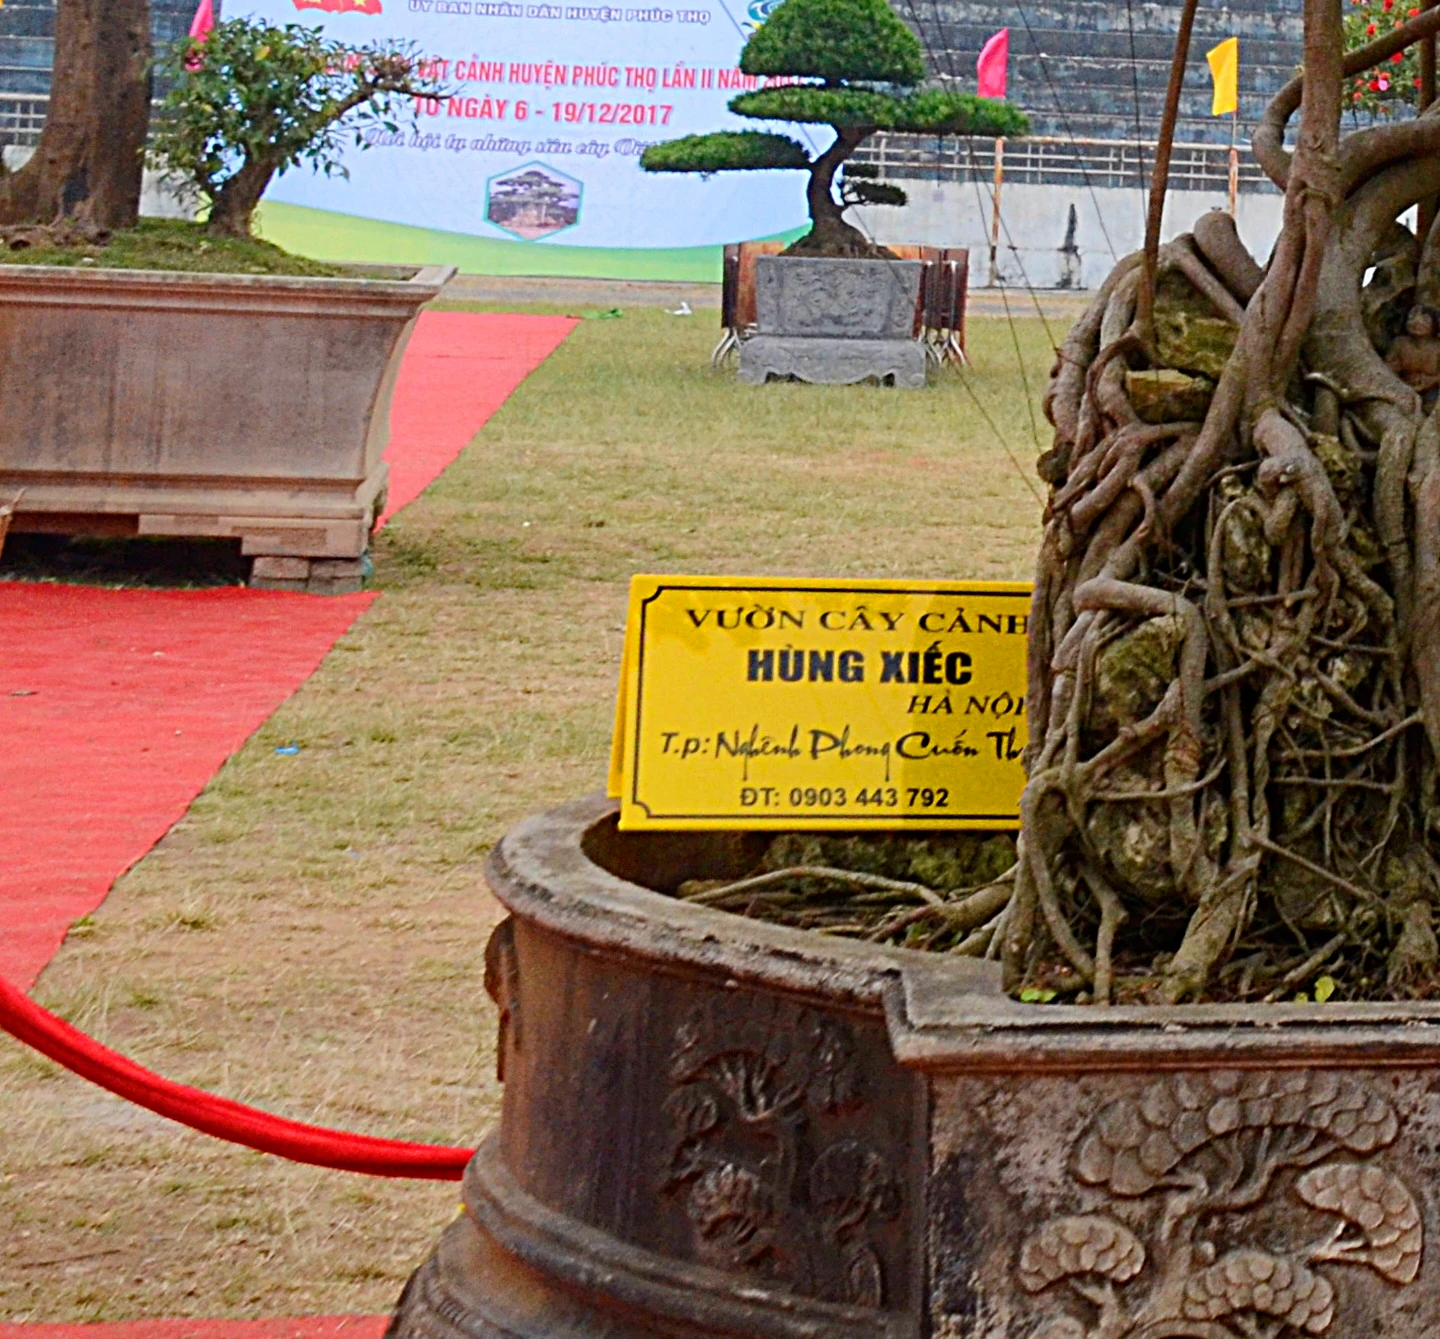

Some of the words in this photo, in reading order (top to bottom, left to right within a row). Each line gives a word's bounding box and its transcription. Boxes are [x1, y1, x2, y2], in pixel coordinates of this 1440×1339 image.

[436, 0, 471, 14] BAN
[475, 1, 522, 17] NHÂN
[527, 3, 562, 19] DÂN
[566, 5, 622, 23] HUYỆN
[626, 7, 673, 22] PHÚC
[676, 9, 711, 25] THỌ
[455, 53, 504, 82] CẢNH
[508, 59, 567, 90] HUYỆN
[572, 61, 618, 87] PHÚC
[625, 66, 656, 93] THỌ
[662, 60, 696, 88] LẦN
[701, 67, 712, 89] II
[449, 93, 507, 120] NGÀY
[514, 99, 527, 121] 6
[552, 101, 673, 125] 19/12/2017
[685, 603, 806, 630] VƯỜN
[819, 605, 905, 632] CÂY
[918, 607, 1028, 635] CẢNH
[746, 643, 865, 683] HÙNG
[879, 640, 973, 686] XIẾC
[906, 689, 954, 715] HÀ
[964, 690, 1026, 720] NỘI
[714, 722, 802, 782] Nghênh
[807, 722, 891, 783] Phong
[895, 729, 979, 761] Cuốn
[985, 725, 1024, 761] Th
[739, 787, 781, 807] ĐT:
[788, 787, 847, 807] 0903
[855, 787, 898, 807] 443
[906, 787, 950, 808] 792
